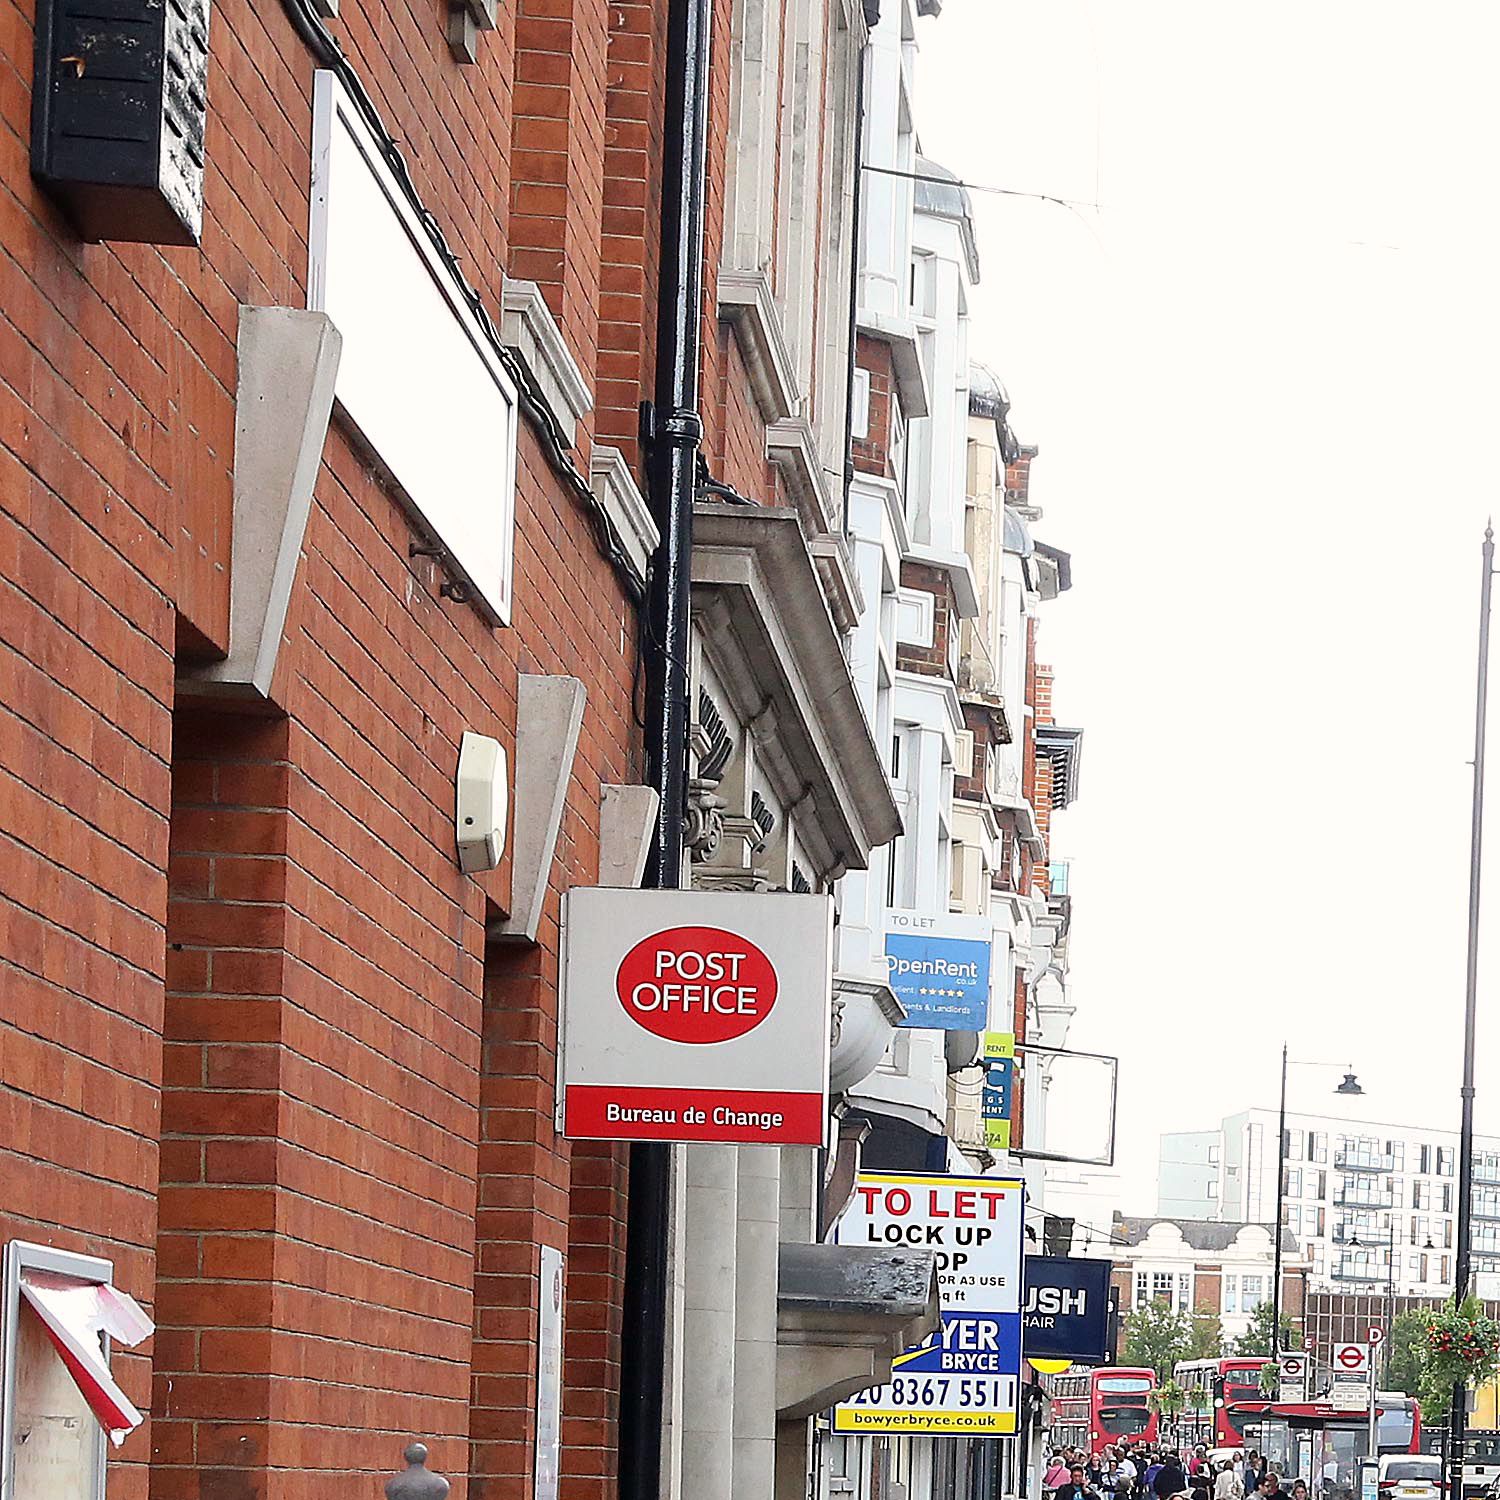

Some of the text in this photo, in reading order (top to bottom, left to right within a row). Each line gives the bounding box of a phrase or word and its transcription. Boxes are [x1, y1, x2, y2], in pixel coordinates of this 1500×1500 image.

[891, 915, 935, 928] TO LET
[656, 951, 746, 981] POST
[887, 955, 977, 978] OpenRent
[632, 983, 757, 1015] OFFICE
[986, 1045, 1006, 1053] RENT
[607, 1104, 783, 1130] Bureau de Change
[858, 1187, 1005, 1219] TO LET
[868, 1223, 992, 1247] LOCK UP
[960, 1276, 975, 1286] A3
[980, 1277, 1006, 1287] USE
[955, 1291, 966, 1301] ft
[1305, 1339, 1312, 1348] E
[1369, 1328, 1383, 1343] D
[942, 1353, 999, 1371] BRYCE
[843, 1379, 1014, 1408] 20 8367 5511
[855, 1413, 996, 1428] bowyerbryce.co.uk
